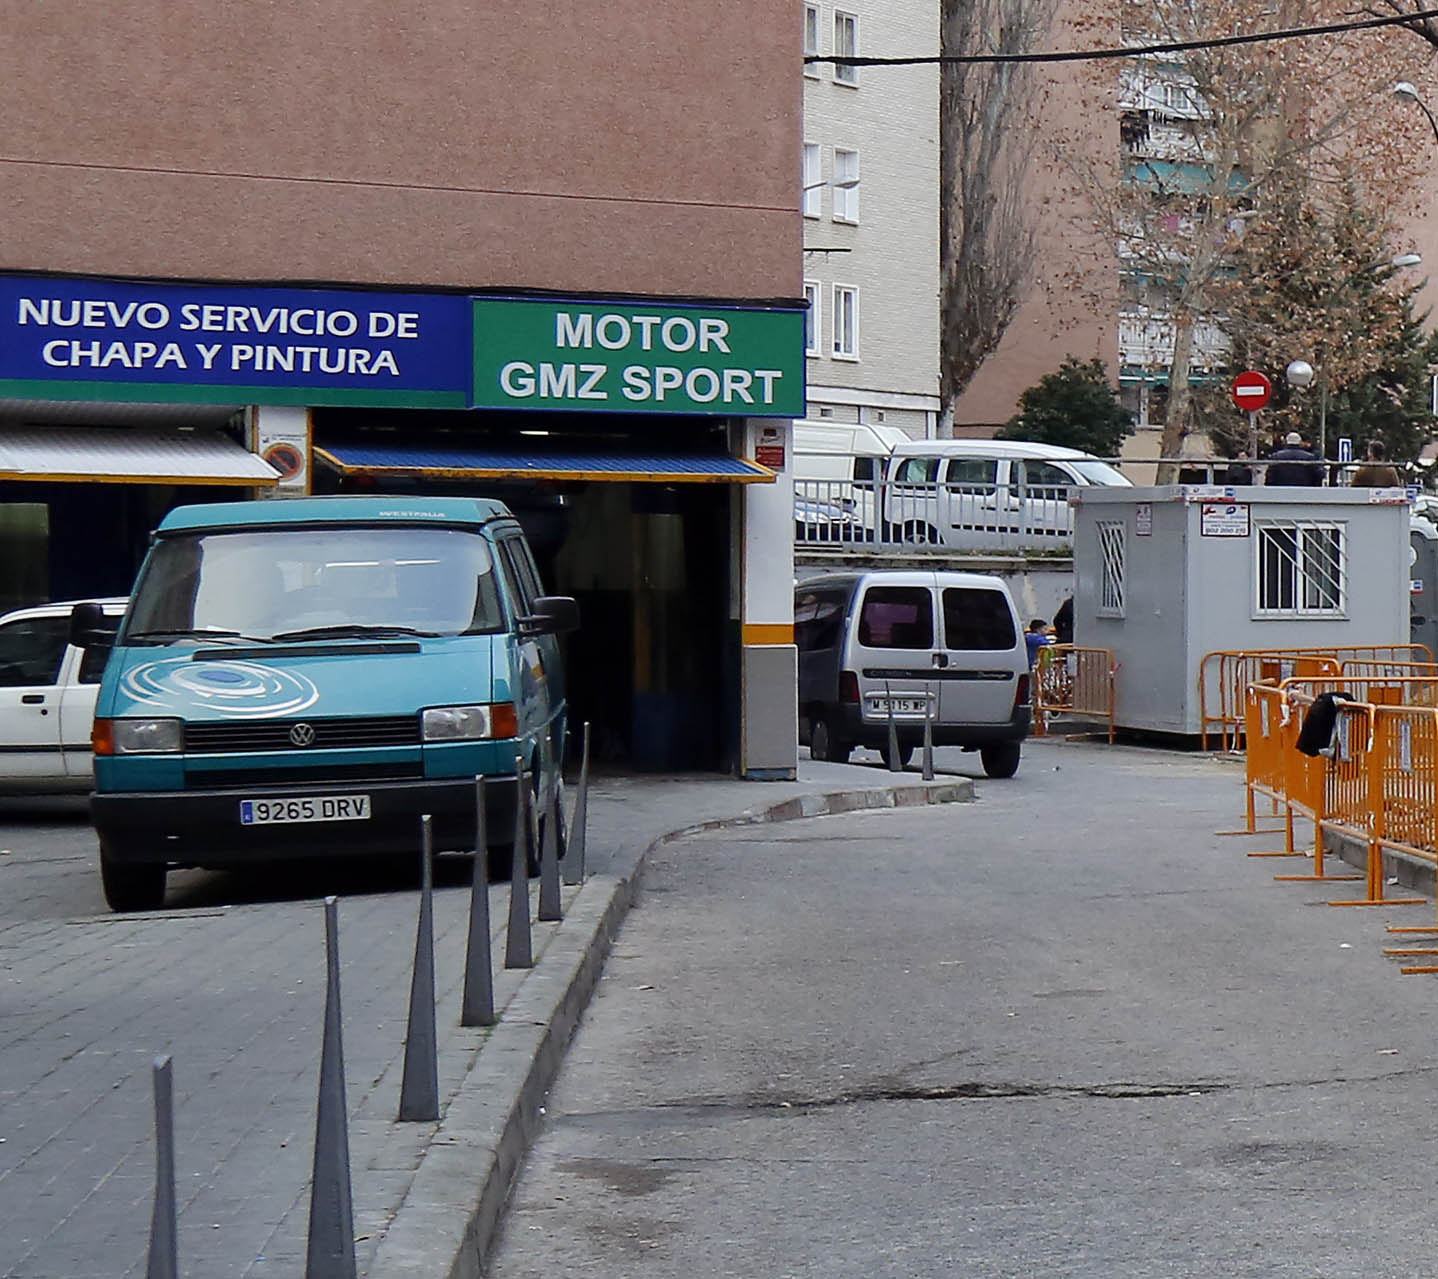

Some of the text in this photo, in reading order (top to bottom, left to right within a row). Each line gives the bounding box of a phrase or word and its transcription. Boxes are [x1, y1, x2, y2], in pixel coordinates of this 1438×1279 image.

[18, 299, 419, 338] NUEVO SERVICIO DE
[555, 312, 731, 354] MOTOR
[42, 340, 400, 376] CHAPA Y PINTURA
[500, 361, 783, 404] GMZ SPORT
[257, 799, 364, 820] 9265 DRV
